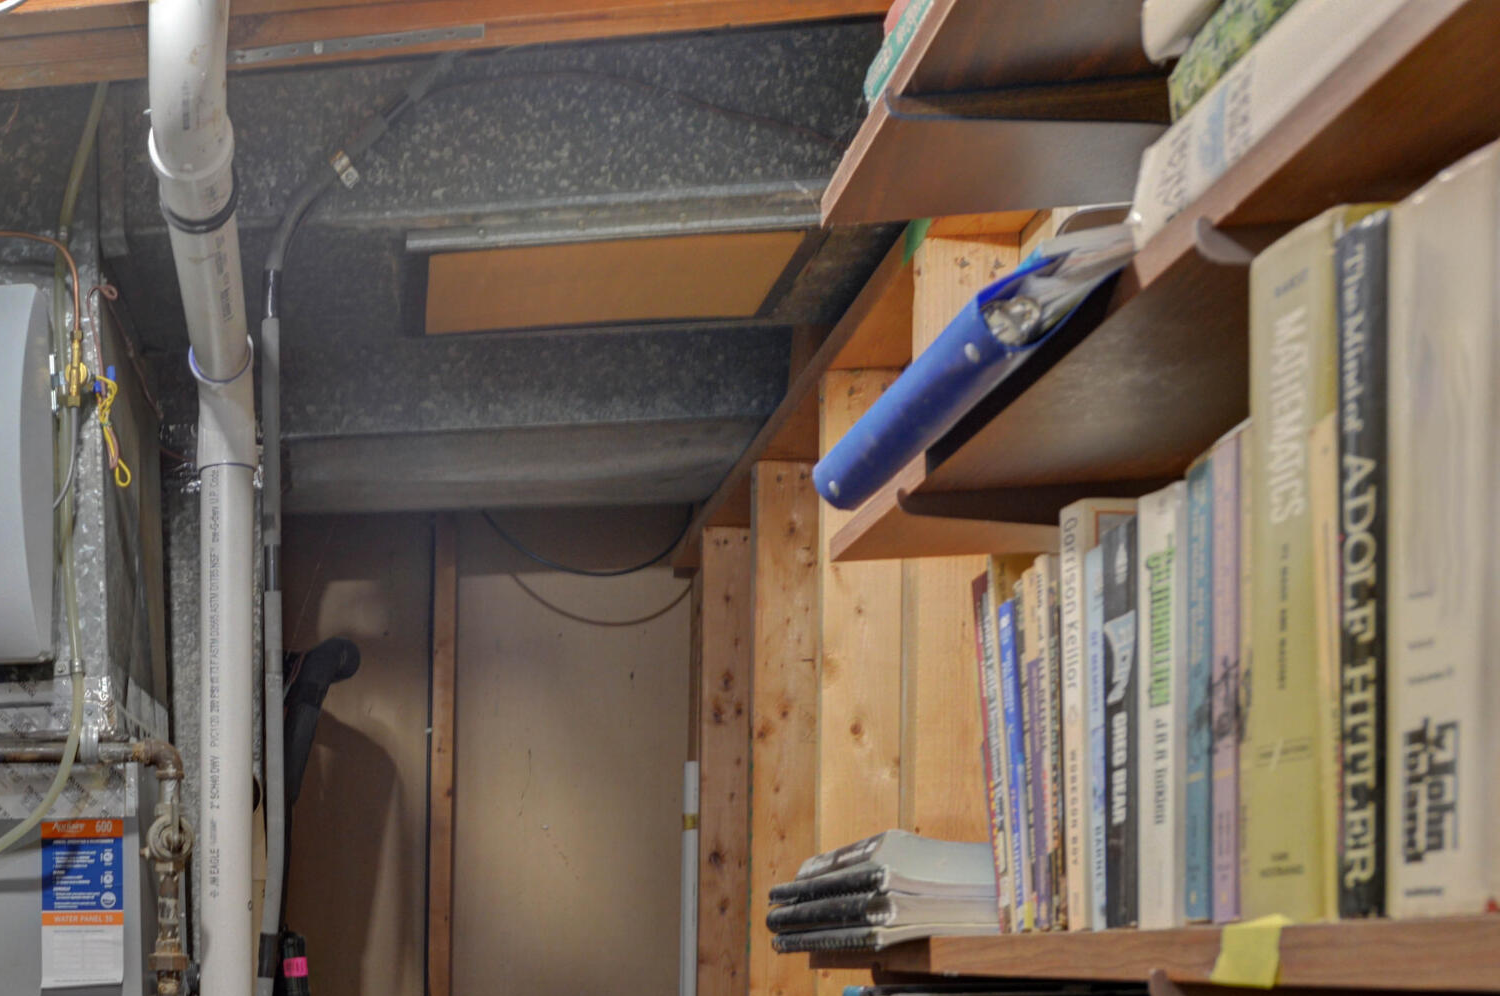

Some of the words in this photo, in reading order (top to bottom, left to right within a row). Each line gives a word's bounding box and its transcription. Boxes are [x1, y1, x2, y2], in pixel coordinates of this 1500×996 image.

[1344, 242, 1366, 310] The
[1267, 306, 1308, 524] MATHEMATICS
[1064, 517, 1079, 616] Garrison
[1343, 454, 1377, 644] ADOLF
[1065, 619, 1079, 690] Keillor
[1069, 749, 1078, 829] WOBEGON
[1111, 768, 1128, 826] BEAR
[1154, 767, 1170, 825] Tolkien
[1343, 656, 1377, 890] HITLER
[95, 821, 113, 833] 600
[209, 848, 219, 875] EAGLE
[53, 915, 78, 923] WATER
[80, 915, 103, 923] PANEL
